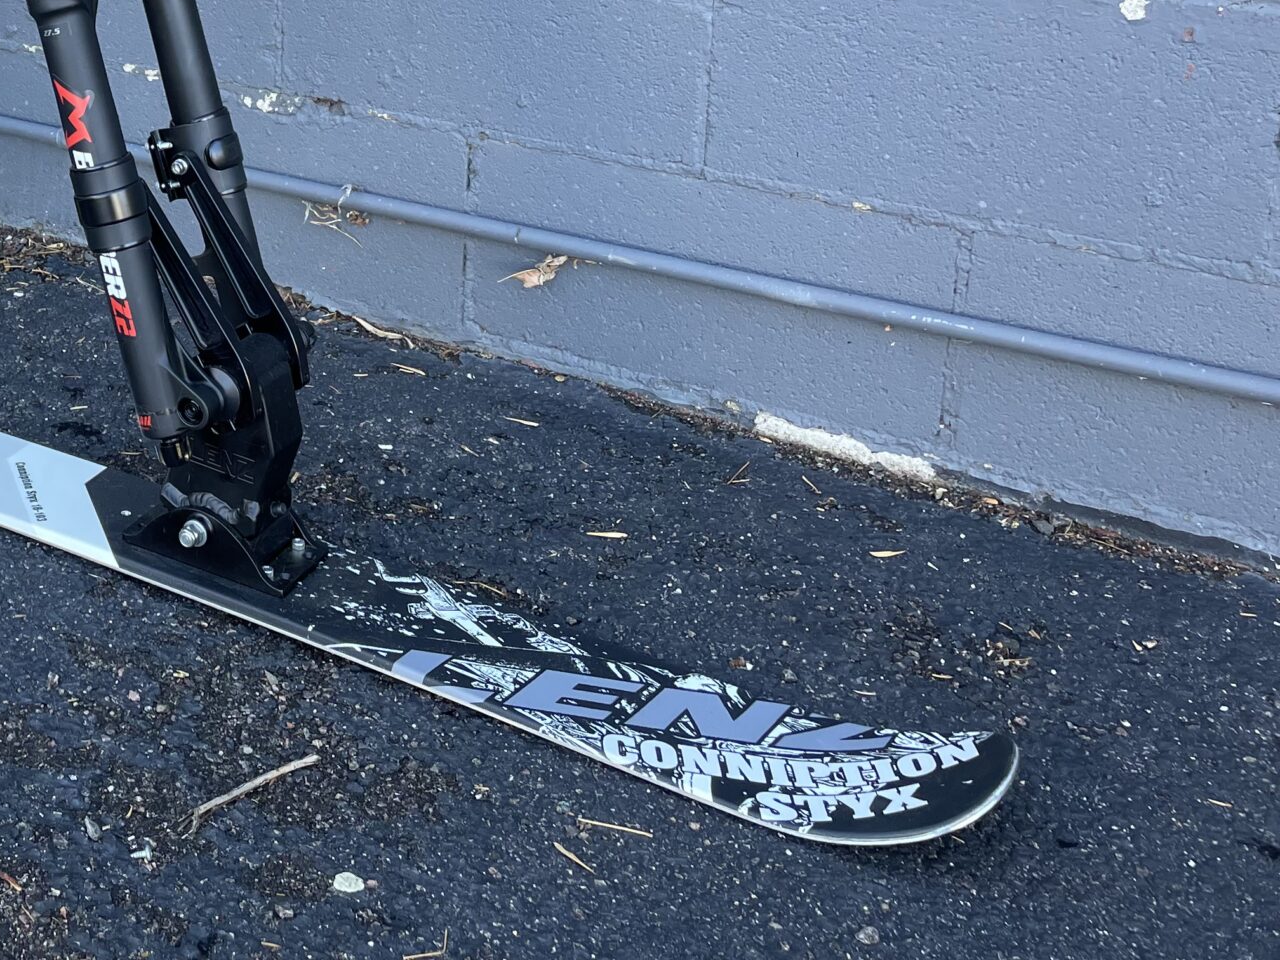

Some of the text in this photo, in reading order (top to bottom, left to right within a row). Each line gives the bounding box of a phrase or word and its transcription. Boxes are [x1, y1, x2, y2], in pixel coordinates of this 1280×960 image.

[188, 447, 257, 485] LENZ
[391, 648, 895, 752] LENZ
[602, 734, 983, 788] CONNIPTION
[757, 782, 930, 824] STYX
